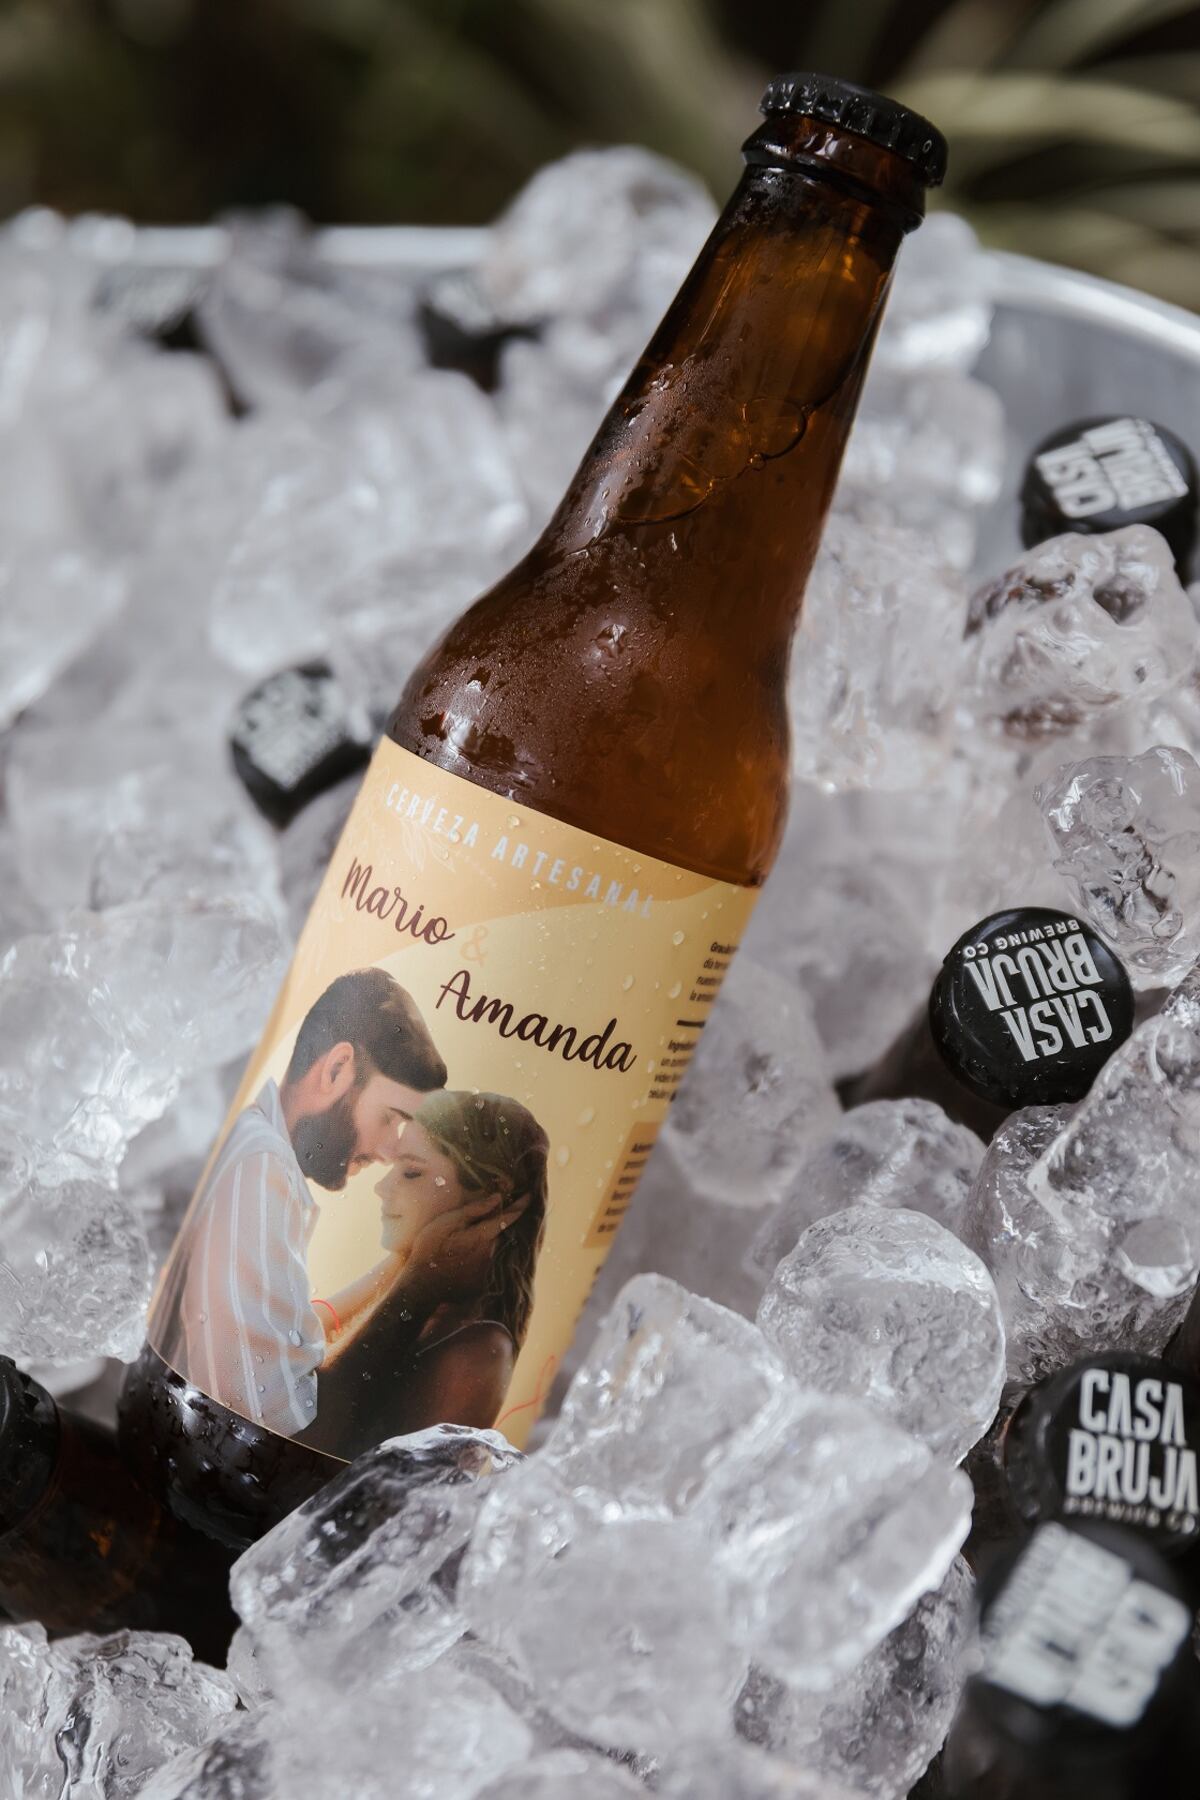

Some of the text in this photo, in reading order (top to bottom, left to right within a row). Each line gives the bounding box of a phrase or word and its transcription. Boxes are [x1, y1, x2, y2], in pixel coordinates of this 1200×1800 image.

[385, 783, 656, 919] CERVEZA ARTESANAL
[341, 857, 456, 945] Mario
[994, 919, 1081, 951] BREWING
[459, 924, 489, 968] &
[964, 933, 1104, 1011] BRUJA
[435, 969, 638, 1073] Amanda
[1000, 989, 1113, 1062] CASA
[1079, 1368, 1187, 1446] CASA
[1066, 1428, 1199, 1514] BRUJA
